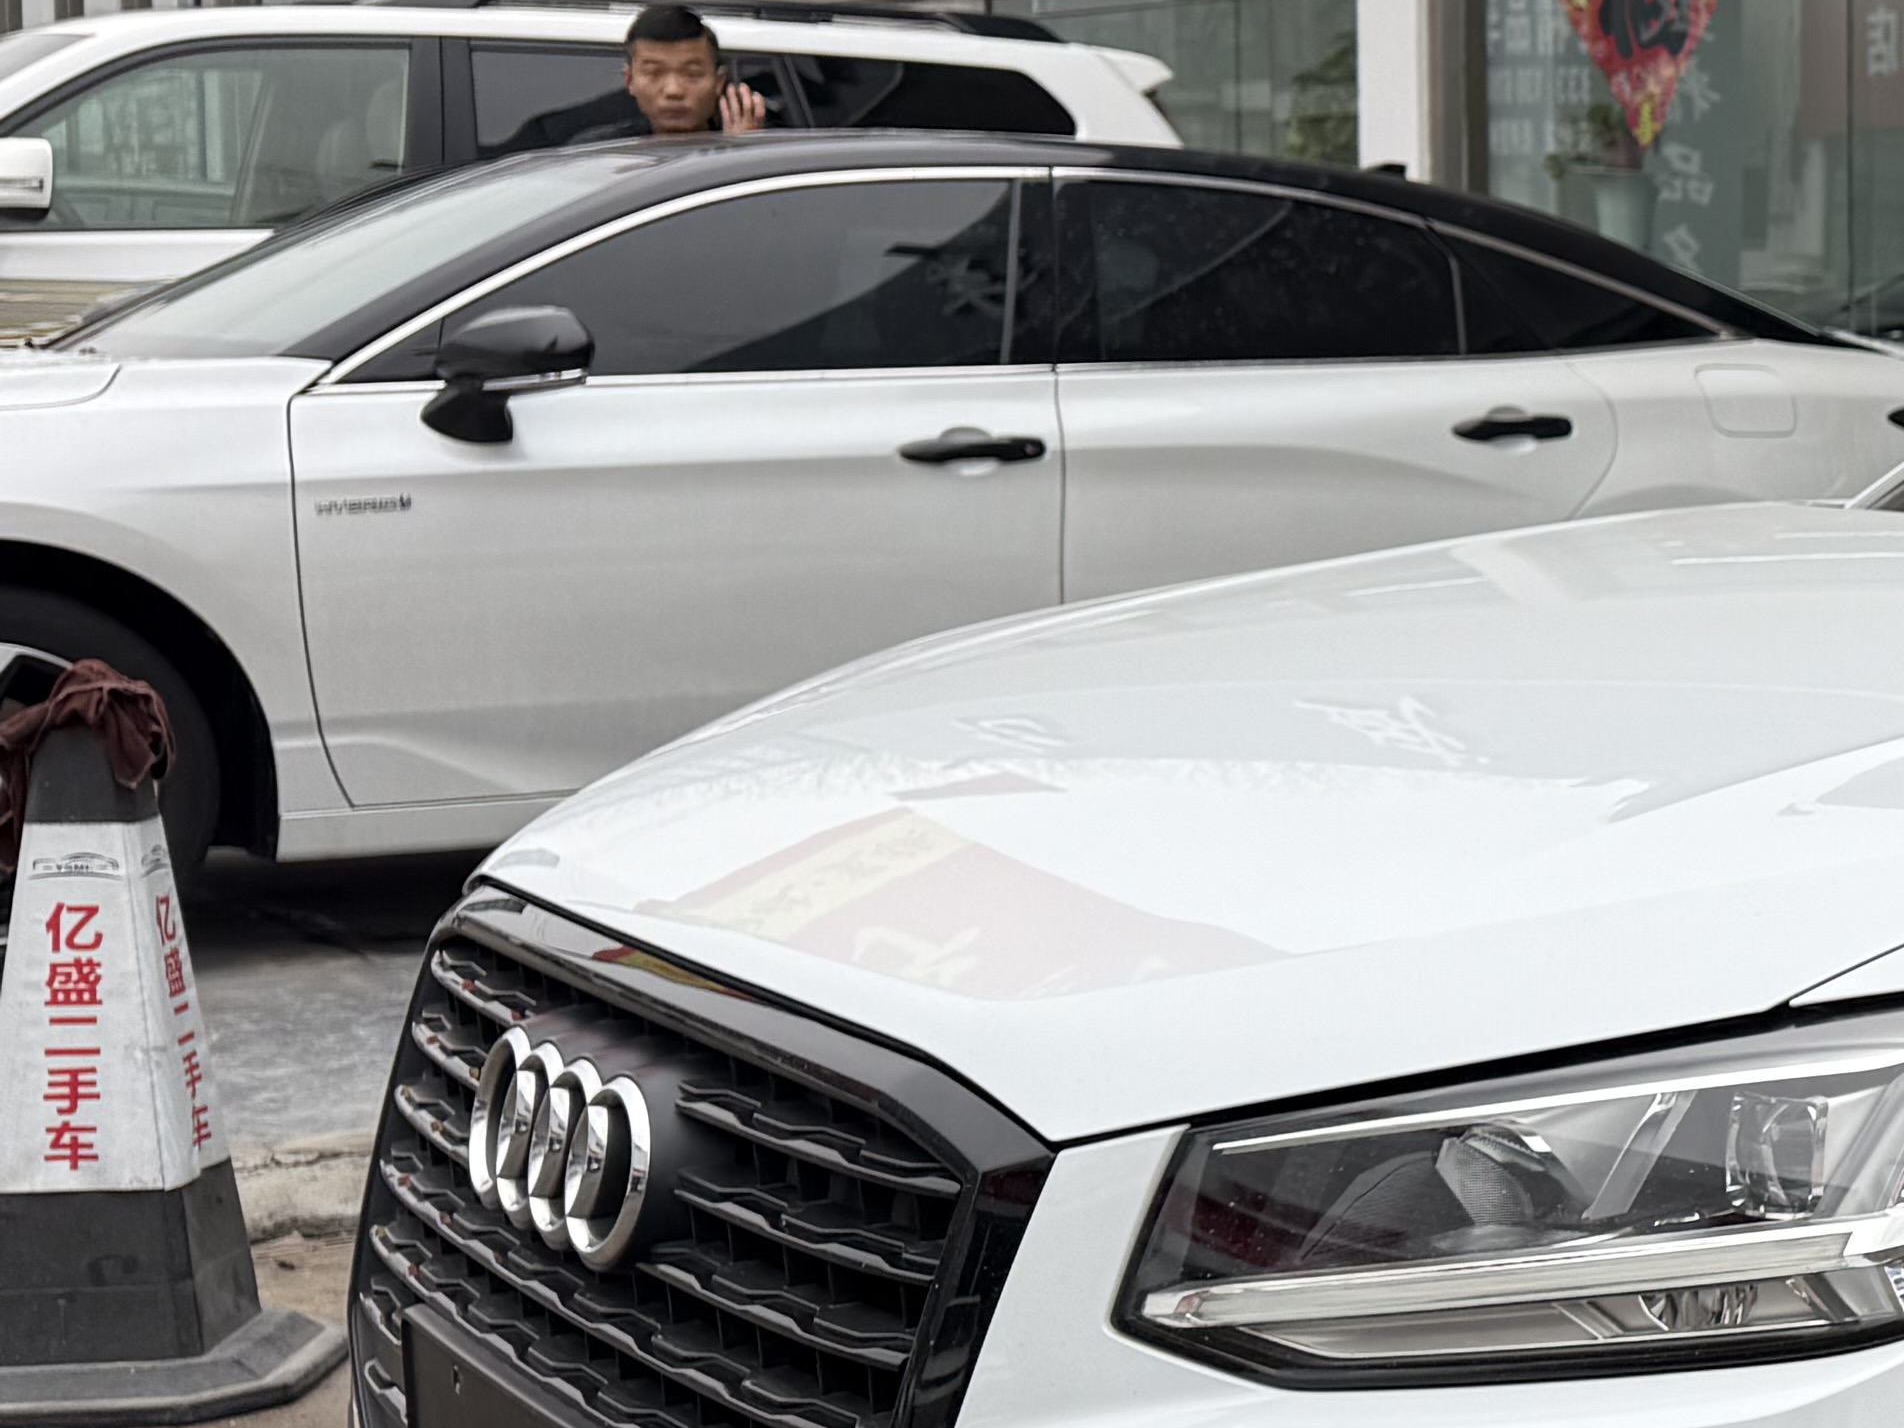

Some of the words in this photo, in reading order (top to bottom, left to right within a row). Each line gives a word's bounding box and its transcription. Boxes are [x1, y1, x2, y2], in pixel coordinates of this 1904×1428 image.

[43, 900, 104, 1173] 亿盛二手车
[155, 892, 214, 1149] 亿盛二手车
